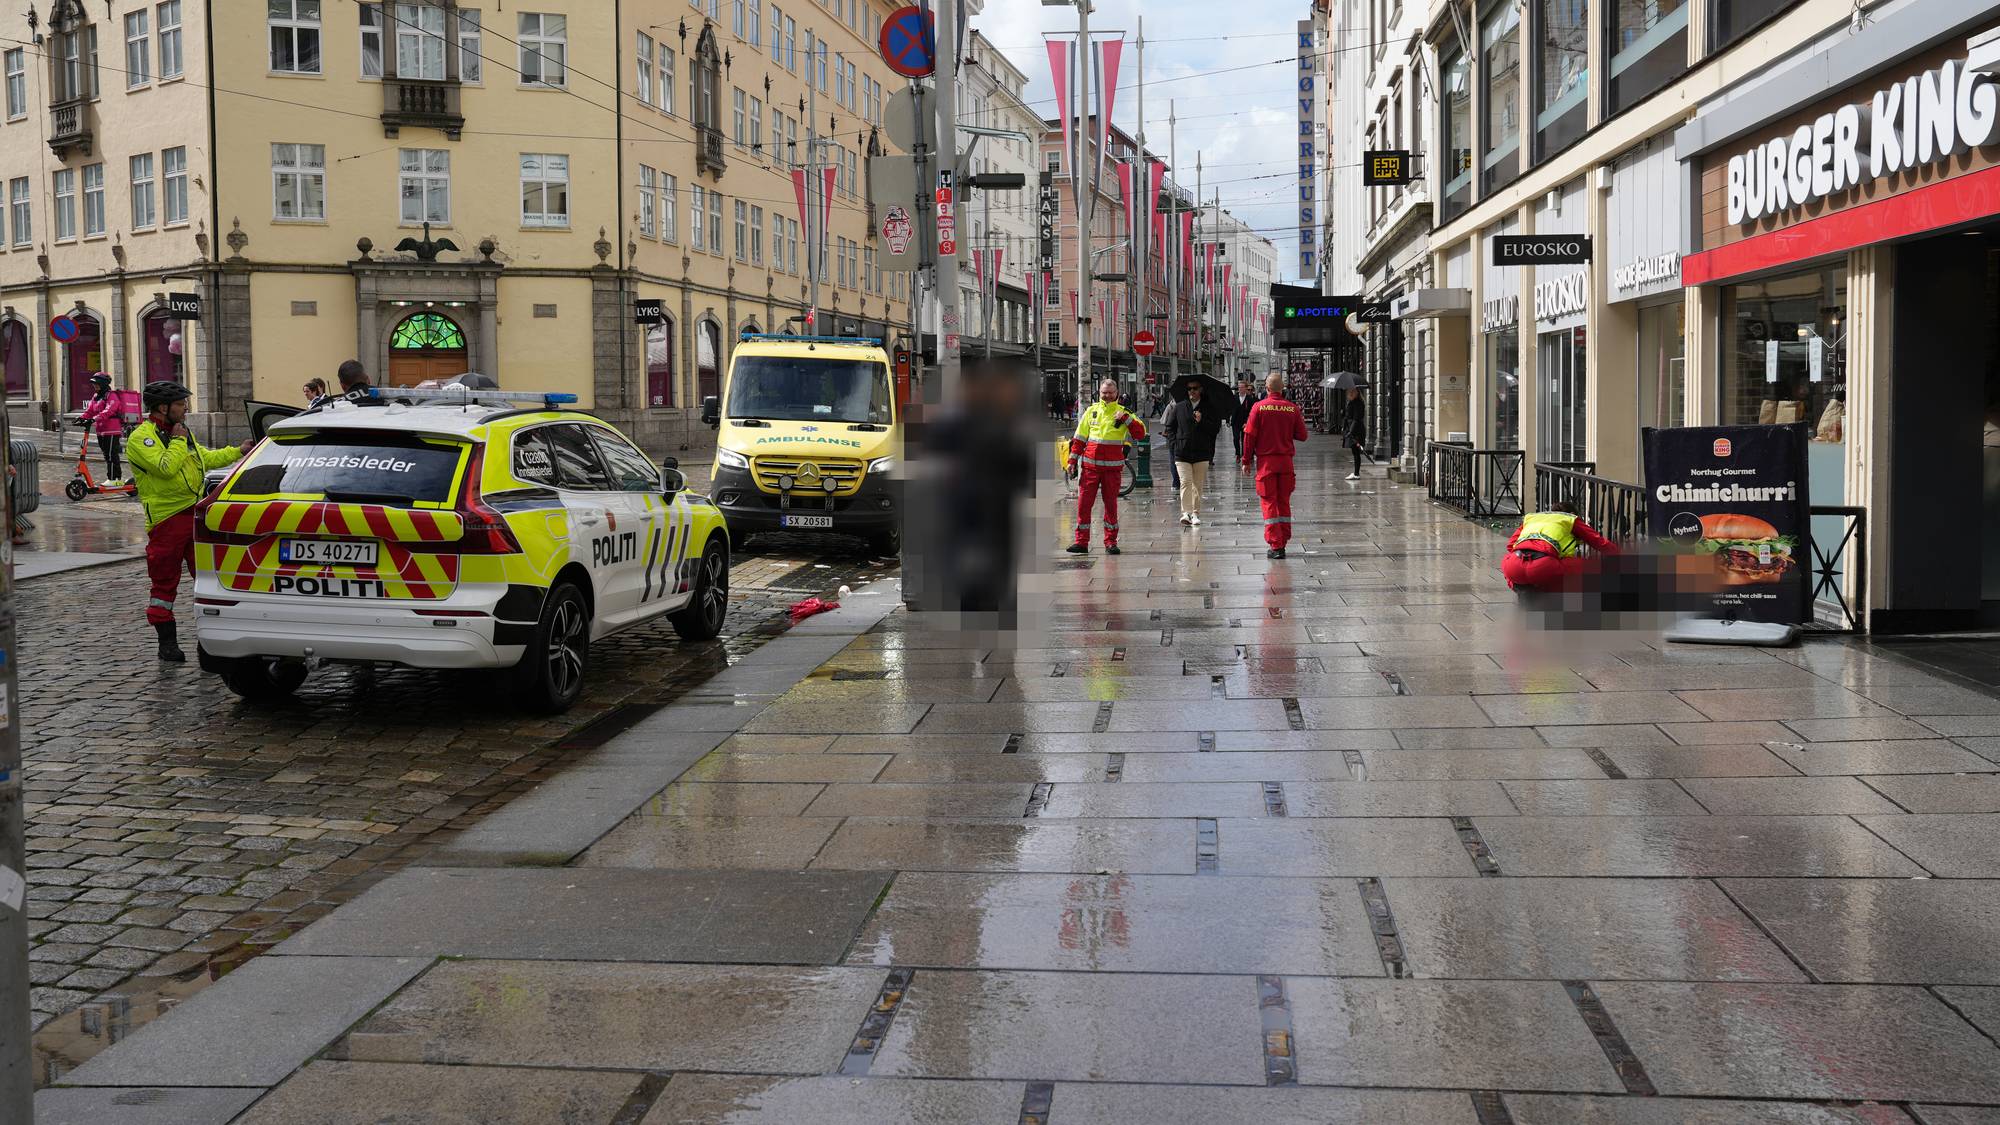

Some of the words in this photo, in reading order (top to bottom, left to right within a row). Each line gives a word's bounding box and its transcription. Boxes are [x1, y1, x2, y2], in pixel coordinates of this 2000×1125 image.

[1728, 104, 1861, 225] BURGER
[1870, 53, 1997, 179] KING
[1299, 32, 1314, 266] KLØVERHUSET
[1041, 186, 1052, 239] HANS
[1503, 242, 1580, 256] EUROSKO
[1640, 251, 1679, 282] GALLERY
[1535, 271, 1587, 320] EUROSKO
[172, 301, 198, 312] LYKO
[637, 307, 660, 316] LYKO
[1297, 307, 1341, 317] APOTEK
[1483, 295, 1514, 331] HAALAND
[1260, 404, 1296, 413] AMBULANSE
[757, 436, 861, 448] AMBULANSE
[282, 455, 416, 473] Innsatsleder
[1690, 468, 1722, 477] Northug
[1722, 468, 1756, 476] Gourmet
[1656, 481, 1796, 502] Chimichurri
[788, 516, 800, 525] SX
[803, 517, 830, 526] 20581
[1673, 524, 1699, 536] Nyhet!
[295, 543, 315, 559] DS
[322, 543, 371, 561] 40271
[592, 531, 637, 568] POLITI
[274, 575, 384, 598] POLITI
